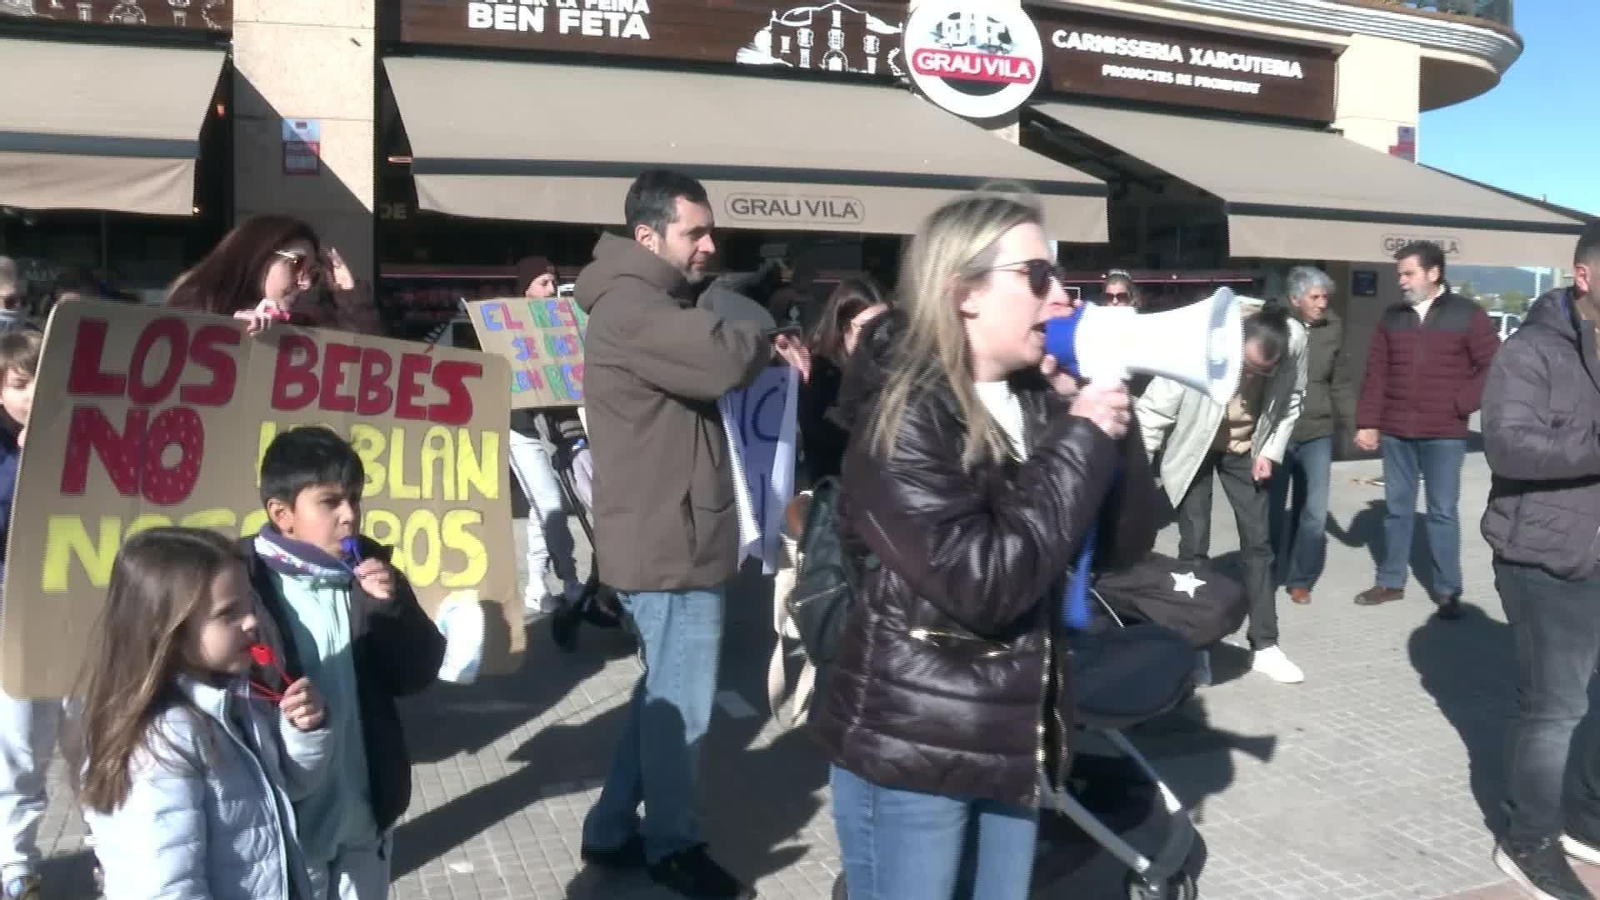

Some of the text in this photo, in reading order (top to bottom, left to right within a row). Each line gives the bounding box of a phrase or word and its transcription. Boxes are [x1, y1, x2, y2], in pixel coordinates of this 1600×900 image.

[467, 2, 650, 40] BEN FETA
[480, 302, 524, 331] EL
[66, 315, 241, 407] LOS
[60, 405, 205, 507] NO
